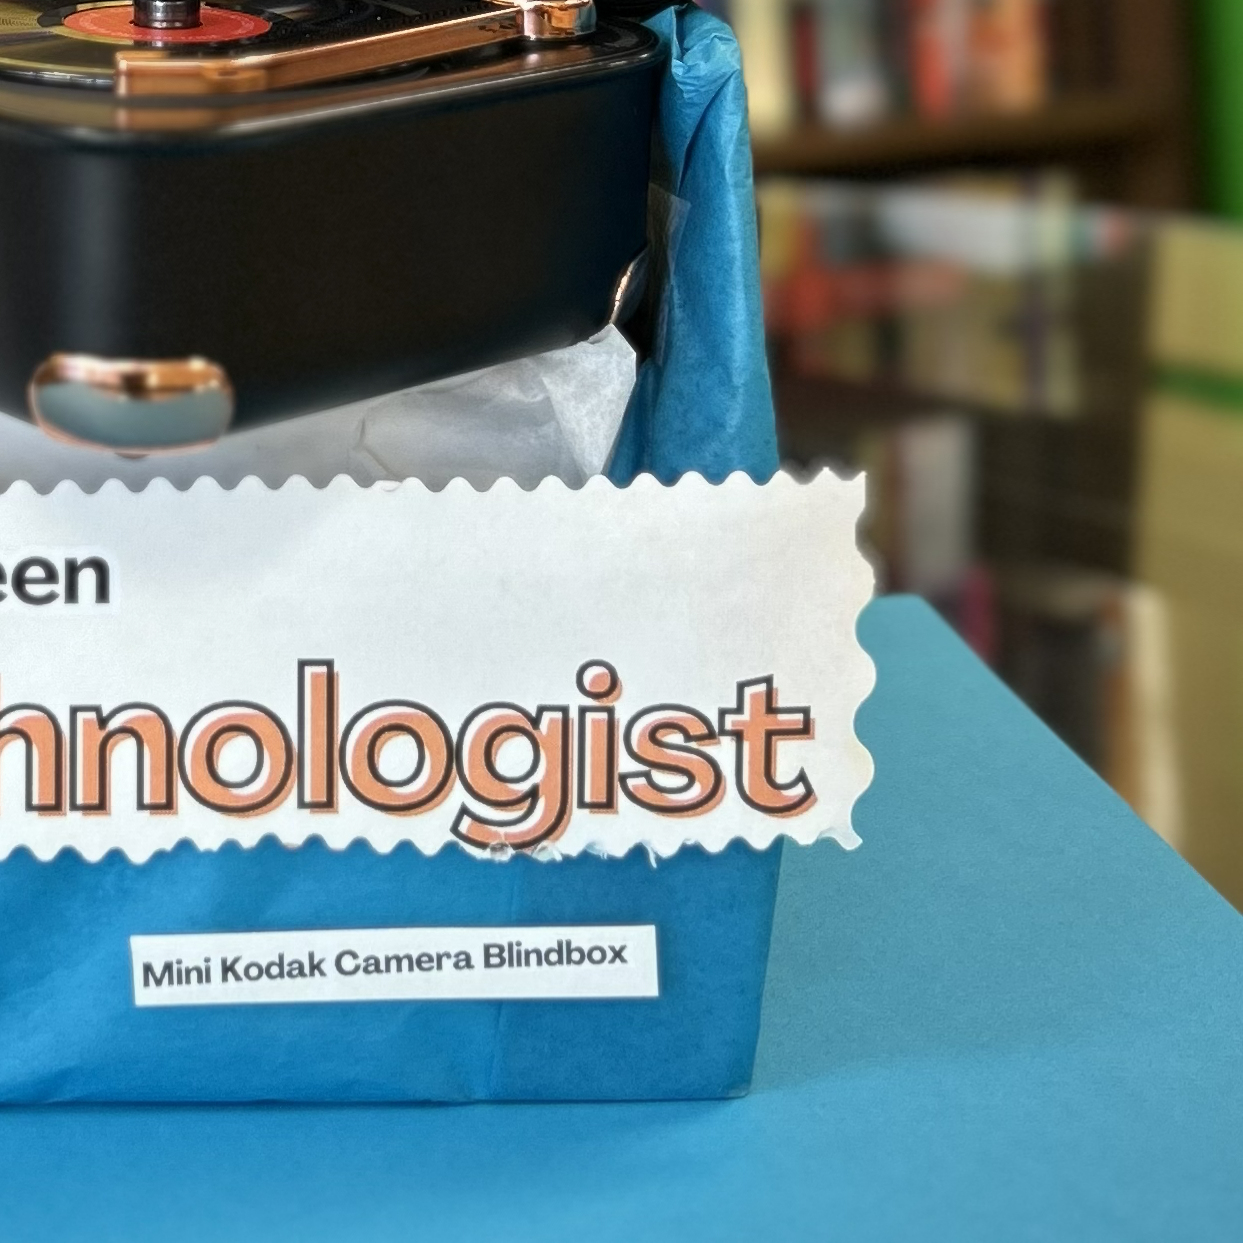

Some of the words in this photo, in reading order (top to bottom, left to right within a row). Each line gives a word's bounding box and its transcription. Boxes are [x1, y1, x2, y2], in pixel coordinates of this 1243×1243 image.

[142, 956, 211, 988] Mini
[220, 951, 327, 984] Kodak
[334, 949, 475, 977] Camera
[483, 939, 628, 969] Blindbox
